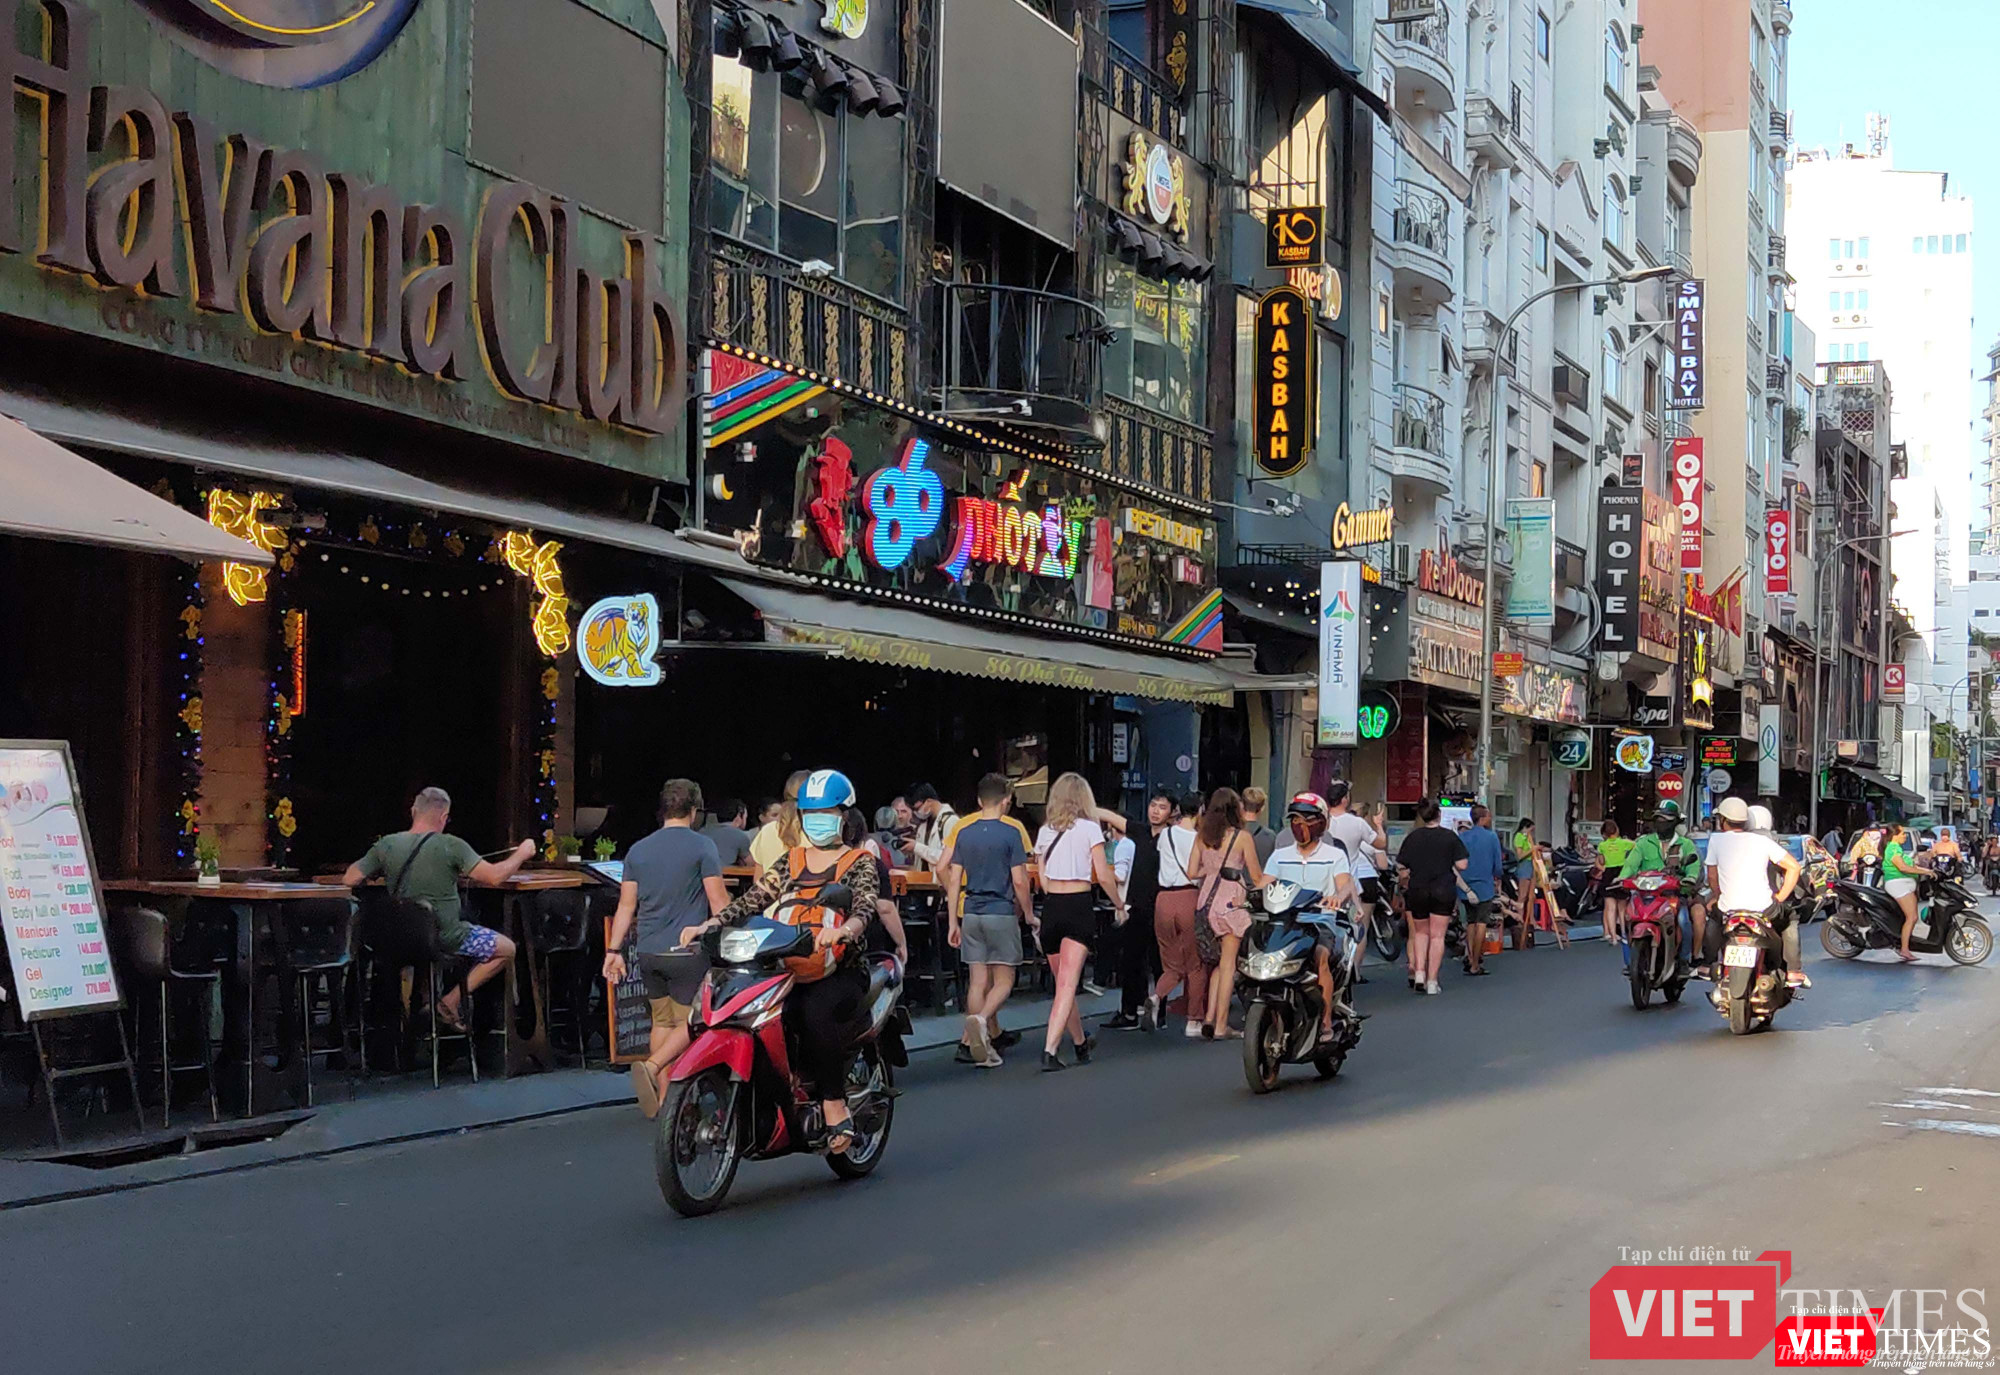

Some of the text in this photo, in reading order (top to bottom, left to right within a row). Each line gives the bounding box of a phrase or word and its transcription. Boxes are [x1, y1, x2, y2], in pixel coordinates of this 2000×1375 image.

[0, 0, 464, 383] Havana
[473, 182, 686, 436] Club
[1679, 281, 1699, 396] SMALL BAY
[1270, 302, 1291, 459] KASBAH
[1674, 397, 1702, 406] HOTEL
[1675, 453, 1700, 526] OYO
[863, 438, 944, 569] 86
[1603, 496, 1639, 505] PHOENIX
[1333, 501, 1394, 549] Gammer
[1770, 521, 1786, 570] OYO
[1604, 514, 1632, 641] HOTEL
[1333, 623, 1344, 684] VINAMA
[985, 656, 1011, 675] 86
[1136, 677, 1157, 694] 86
[1632, 706, 1670, 724] Spa
[1559, 744, 1580, 761] 24
[1658, 781, 1683, 790] OYO
[8, 886, 31, 900] Body
[12, 906, 34, 920] Body
[16, 926, 58, 939] Manicure
[21, 946, 60, 961] Pedicure
[25, 967, 43, 981] Gel
[29, 985, 73, 1001] Designer
